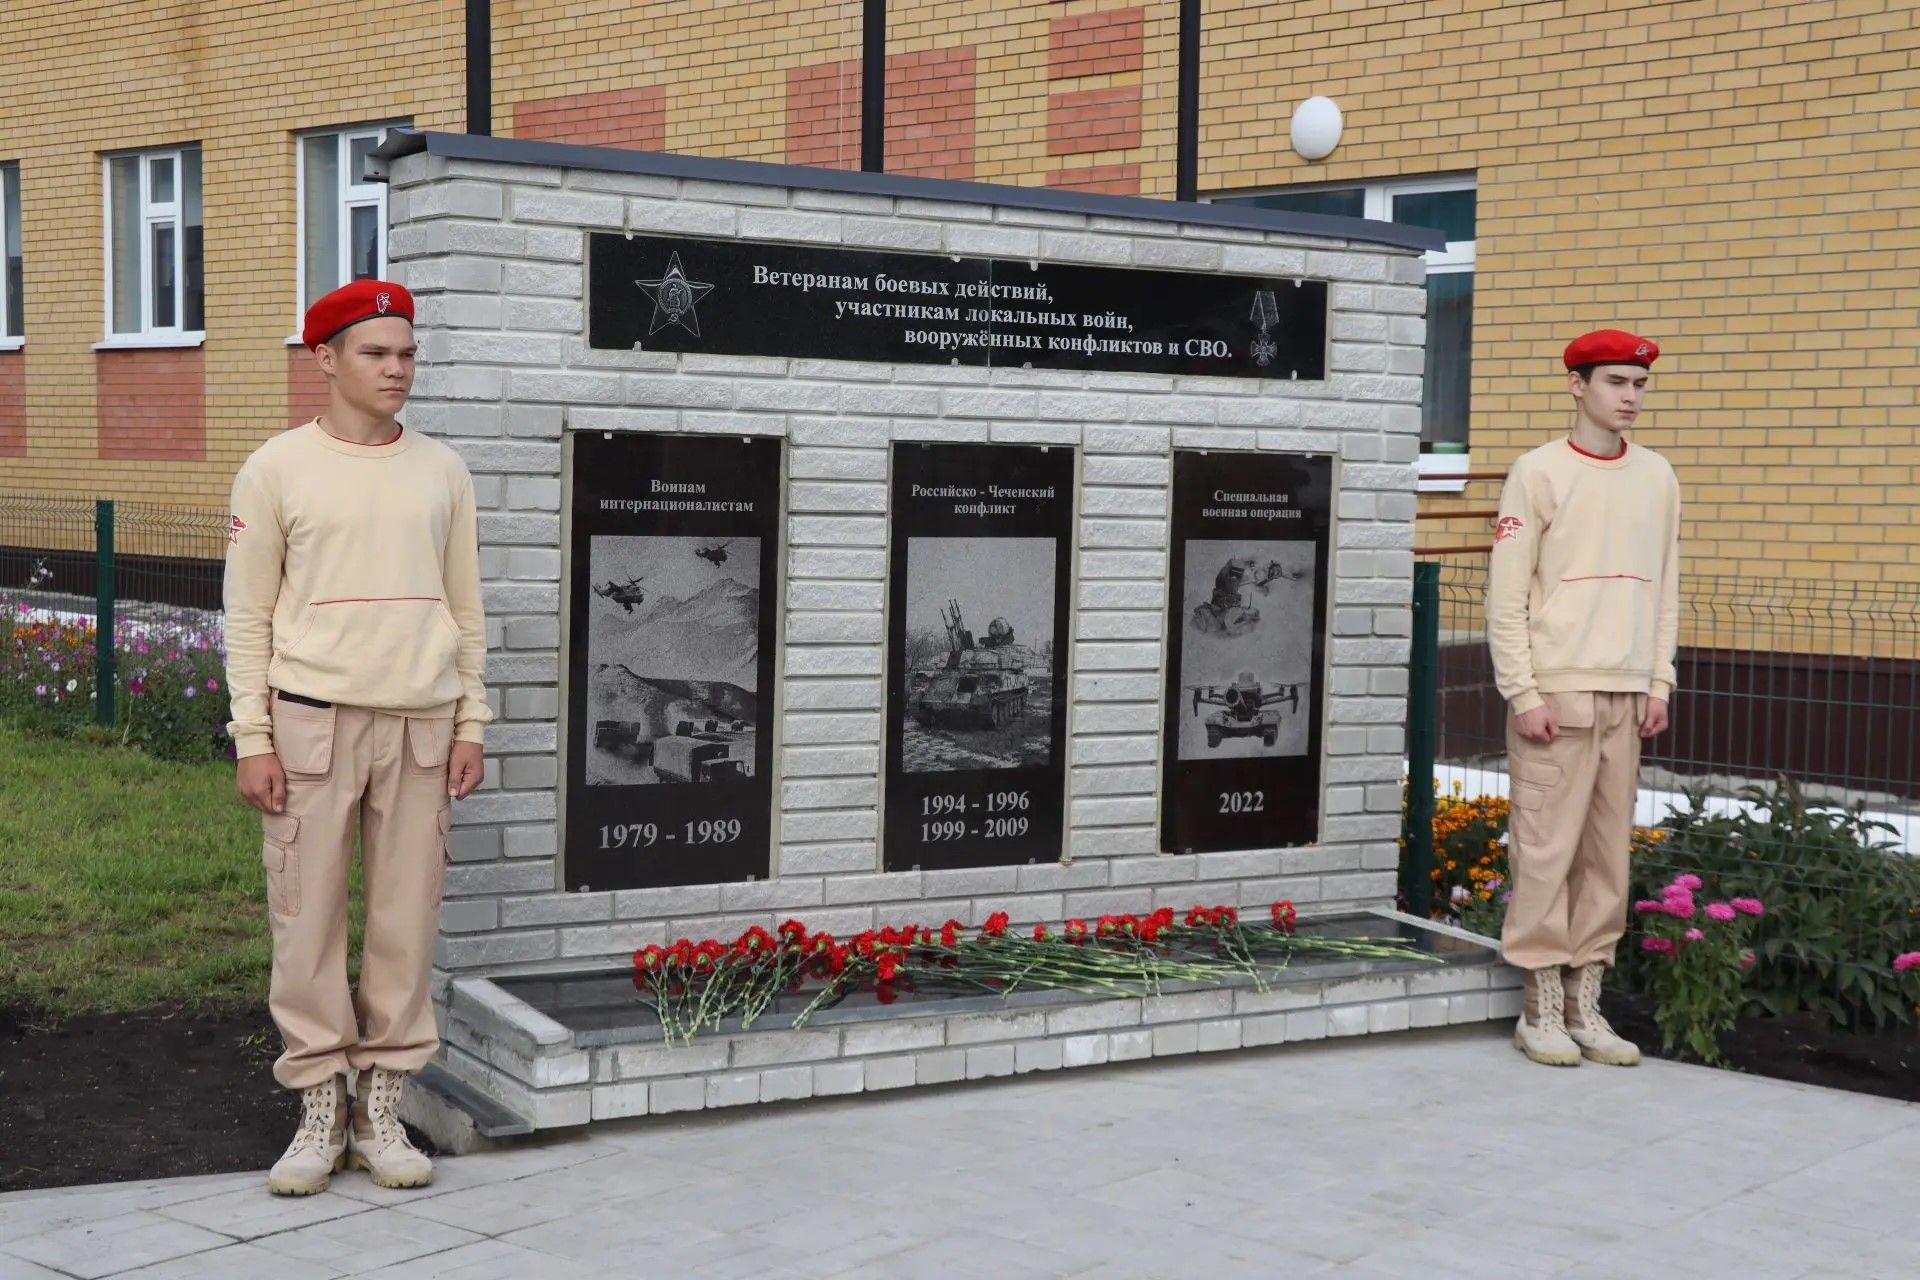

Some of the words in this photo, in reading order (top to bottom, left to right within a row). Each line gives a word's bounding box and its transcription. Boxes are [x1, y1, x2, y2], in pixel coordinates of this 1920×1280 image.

[752, 265, 869, 292] Ветеранам
[875, 274, 950, 296] боевых
[954, 280, 1054, 304] действий,
[835, 300, 960, 321] участникам
[965, 307, 1077, 327] локальных
[1082, 311, 1134, 333] войн,
[904, 329, 1043, 351] вооружённых
[1047, 334, 1163, 356] конфликтов
[1168, 342, 1180, 355] и
[1184, 338, 1233, 358] СВО.
[650, 479, 706, 494] Воинам
[911, 484, 977, 497] Российско
[988, 485, 1055, 498] Чеченский
[1214, 489, 1289, 503] Специальная
[600, 499, 754, 513] интернационалистам
[954, 501, 1017, 517] конфликт
[1202, 508, 1248, 518] военная
[1250, 509, 1302, 521] операция
[921, 794, 966, 816] 1994
[986, 790, 1030, 812] 1996
[1218, 791, 1264, 813] 2022
[599, 823, 658, 849] 1979
[684, 818, 742, 845] 1989
[921, 820, 966, 842] 1999
[984, 816, 1029, 838] 2009
